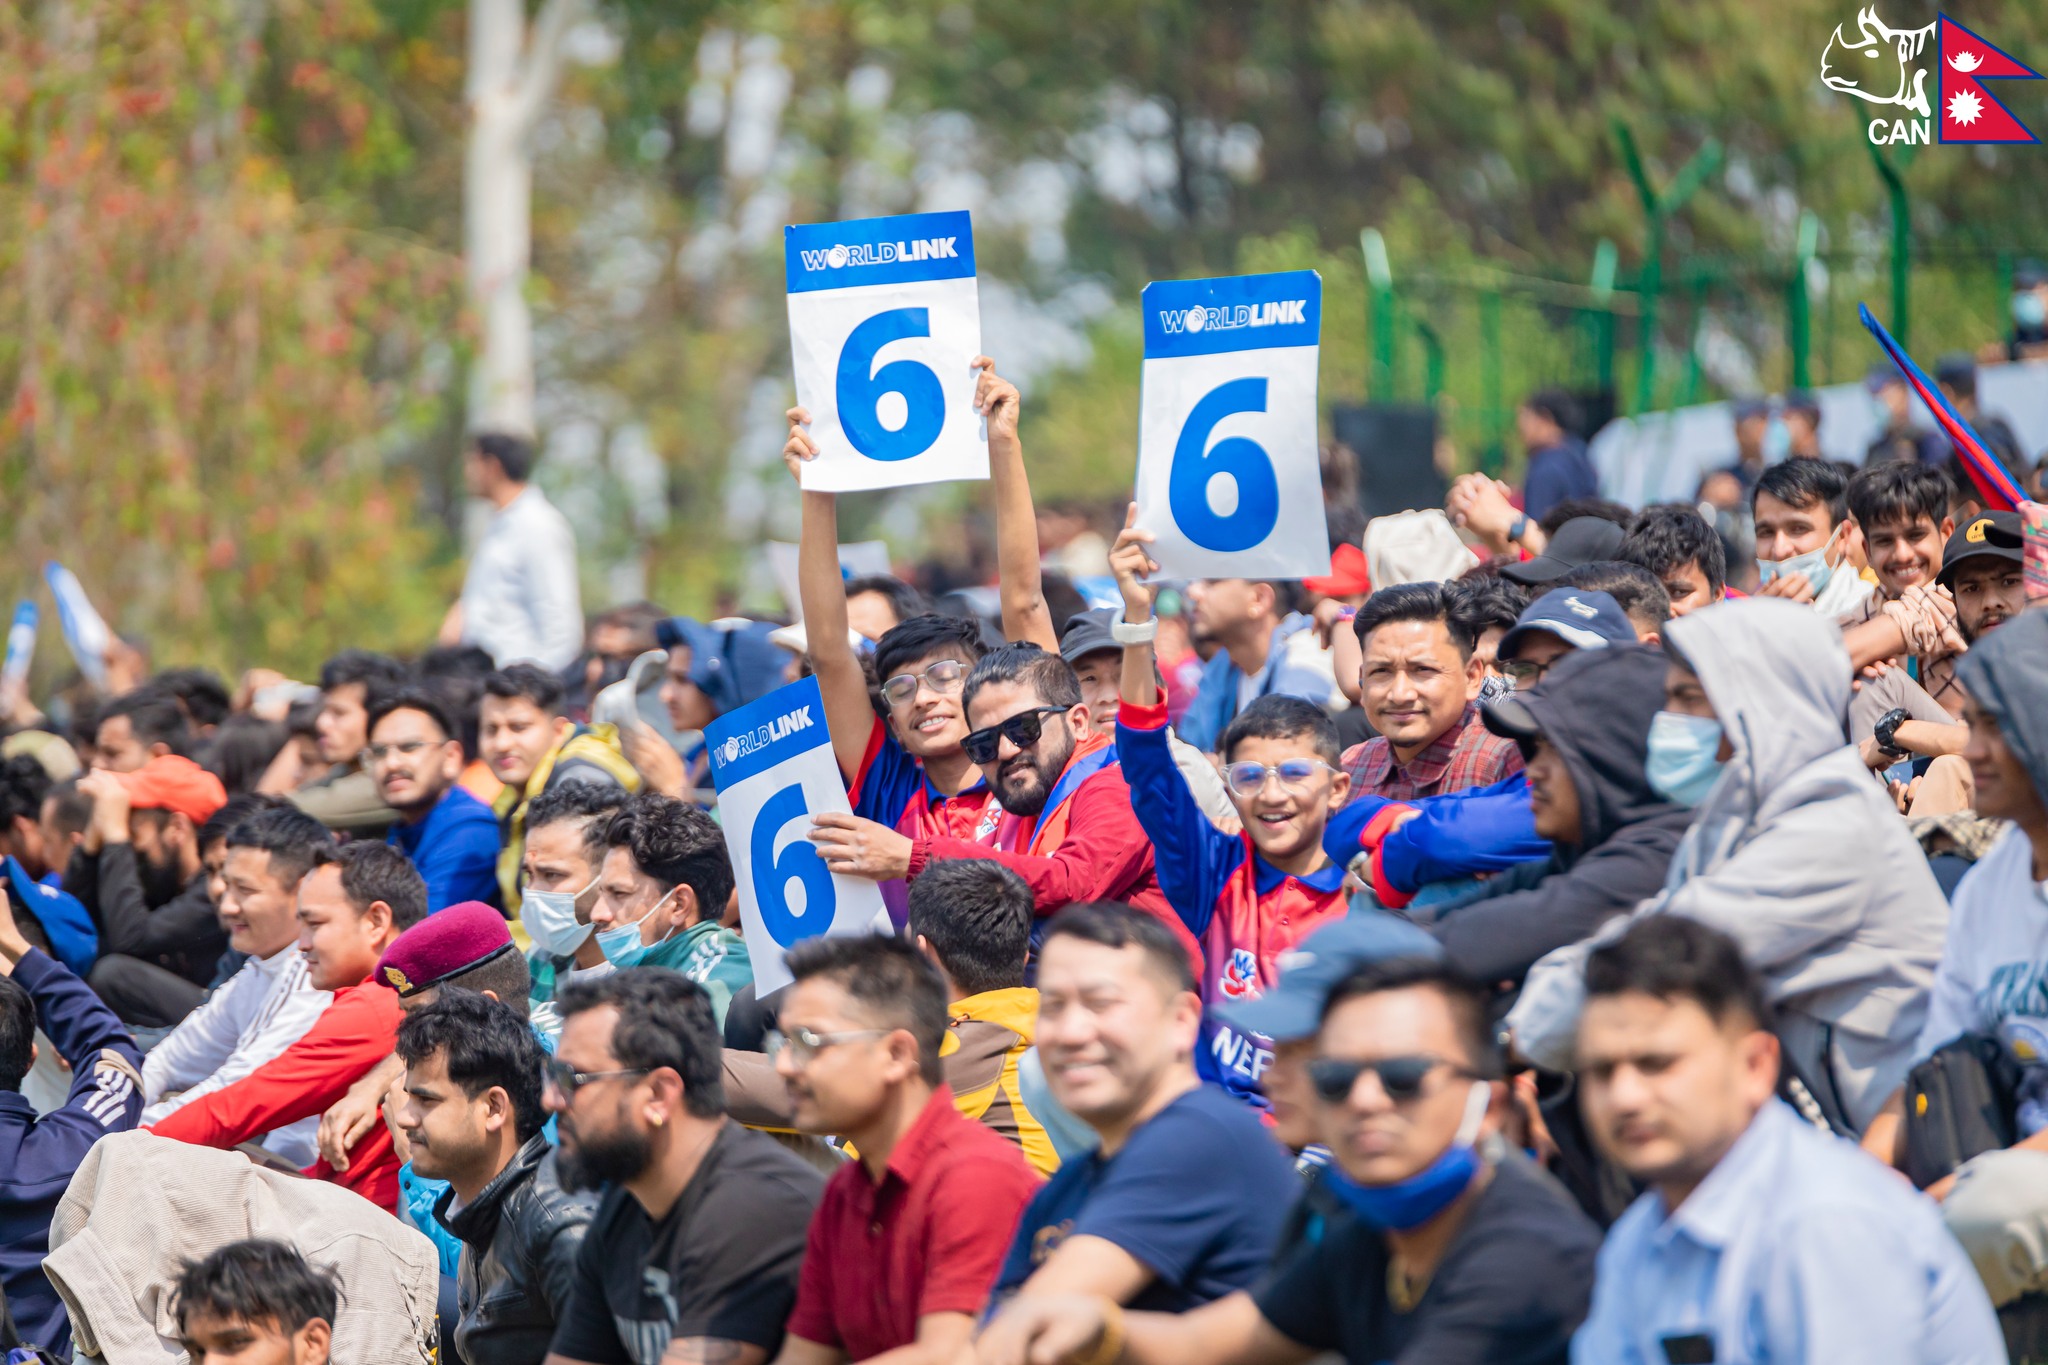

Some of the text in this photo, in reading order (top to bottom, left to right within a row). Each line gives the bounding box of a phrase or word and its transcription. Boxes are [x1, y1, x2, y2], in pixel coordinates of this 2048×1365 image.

[800, 236, 959, 271] WORLDLINK
[1160, 299, 1307, 334] WORLDLINK
[836, 306, 946, 462] 6
[1168, 376, 1280, 553] 6
[713, 704, 815, 770] WORLDLINK
[750, 781, 837, 951] 6
